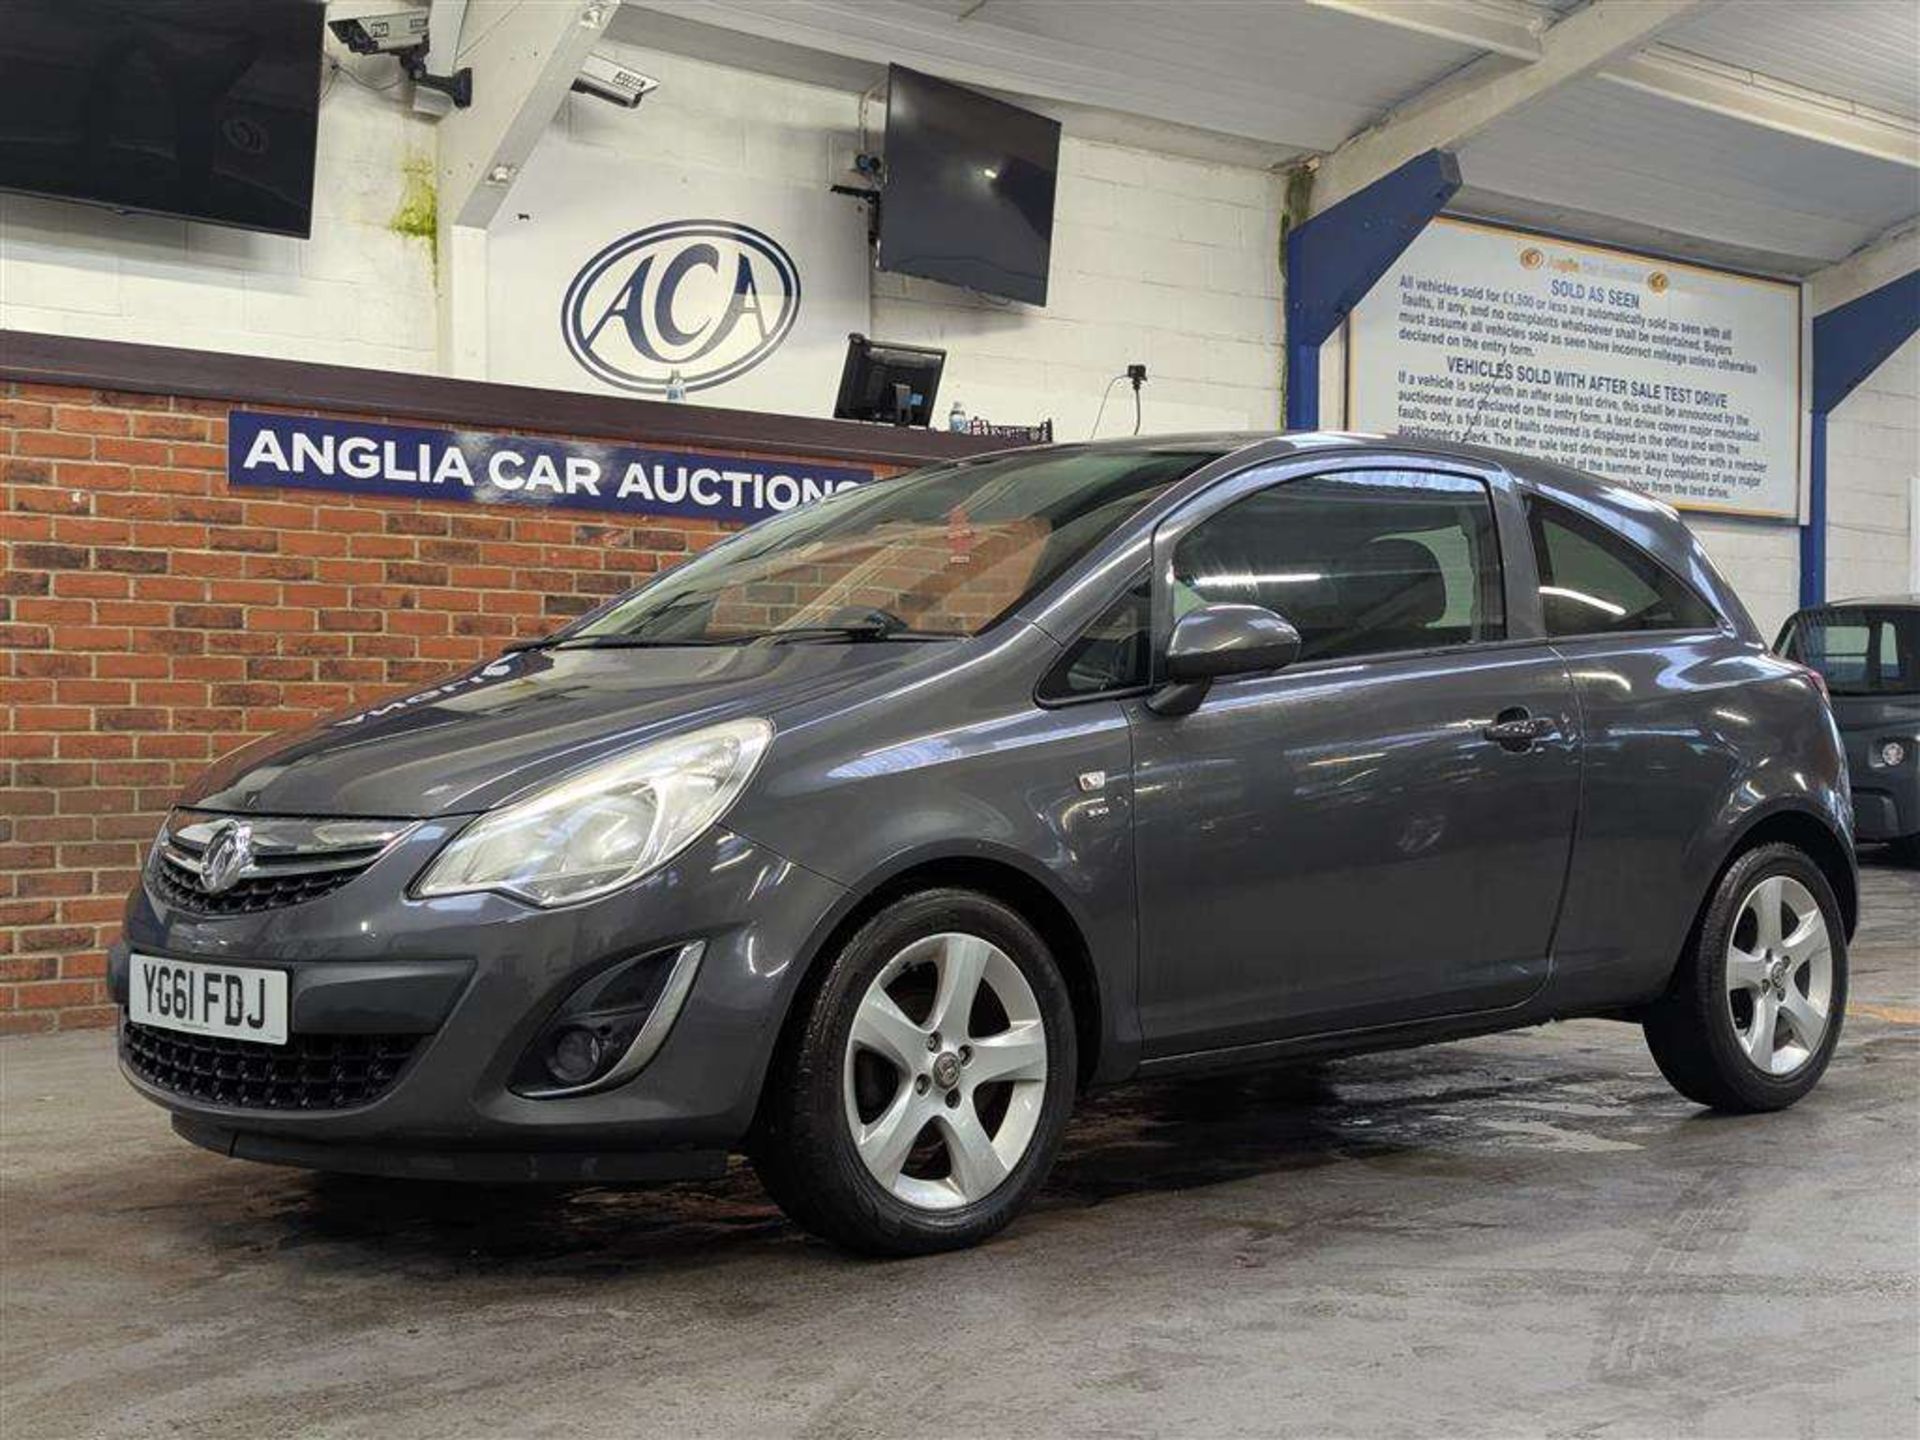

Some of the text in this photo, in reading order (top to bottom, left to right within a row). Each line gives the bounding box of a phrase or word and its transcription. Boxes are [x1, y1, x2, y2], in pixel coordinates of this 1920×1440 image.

[584, 243, 766, 363] ACA
[1399, 275, 1414, 289] All
[1417, 279, 1461, 297] vehicles
[1463, 287, 1484, 300] sold
[1486, 289, 1500, 303] for
[1537, 300, 1546, 310] or
[1648, 317, 1667, 330] sold
[1681, 324, 1701, 335] seen
[1703, 326, 1720, 338] with
[1722, 329, 1733, 340] all
[1552, 280, 1640, 310] SOLD AS SEEN
[1398, 327, 1444, 345] declared
[1447, 337, 1460, 347] on
[1462, 337, 1479, 350] the
[1481, 341, 1507, 356] entry
[1399, 314, 1426, 326] must
[1427, 318, 1468, 332] assume
[1471, 322, 1483, 334] all
[1485, 325, 1527, 340] vehicles
[1528, 332, 1549, 343] sold
[1550, 336, 1562, 345] as
[1564, 338, 1586, 349] seen
[1588, 339, 1609, 352] have
[1612, 344, 1652, 359] incorrect
[1471, 306, 1490, 318] and
[1492, 310, 1504, 320] no
[1507, 312, 1559, 328] complaints
[1616, 327, 1636, 340] shall
[1639, 330, 1649, 342] be
[1409, 376, 1416, 384] a
[1417, 375, 1454, 389] vehicle
[1457, 380, 1465, 390] is
[1494, 385, 1514, 396] with
[1516, 389, 1528, 398] an
[1530, 389, 1551, 401] after
[1554, 393, 1574, 404] sale
[1576, 394, 1592, 406] test
[1665, 406, 1676, 416] be
[1725, 413, 1735, 426] by
[1736, 415, 1749, 425] the
[1516, 366, 1551, 385] SOLD
[1554, 371, 1585, 390] WITH
[1589, 376, 1627, 395] AFTER
[1631, 381, 1661, 399] SALE
[1664, 386, 1692, 403] TEST
[1695, 390, 1727, 408] DRIVE
[1398, 392, 1453, 407] auctioneer
[1456, 398, 1475, 409] and
[1523, 408, 1535, 416] on
[1537, 407, 1551, 418] the
[1554, 410, 1578, 423] entry
[1606, 415, 1612, 425] A
[1614, 416, 1633, 427] test
[1635, 419, 1656, 430] drive
[1658, 424, 1687, 434] covers
[1398, 407, 1427, 420] faults
[1457, 416, 1463, 424] a
[1485, 416, 1501, 428] list
[1502, 419, 1512, 430] of
[1515, 420, 1541, 433] faults
[1543, 426, 1580, 437] covered
[1583, 429, 1592, 438] is
[1593, 429, 1637, 445] displayed
[1639, 435, 1647, 444] in
[1648, 435, 1663, 446] the
[1665, 437, 1689, 449] office
[1691, 441, 1706, 451] and
[1709, 443, 1726, 453] with
[243, 430, 474, 486] ANGLIA
[488, 450, 600, 495] CAR
[1495, 434, 1512, 446] The
[1514, 436, 1536, 448] after
[1540, 439, 1558, 451] sale
[1560, 441, 1578, 453] test
[1581, 443, 1602, 455] drive
[1629, 448, 1640, 459] be
[1647, 465, 1662, 478] Any
[1712, 472, 1720, 482] of
[144, 963, 265, 1030] YG61 FDJ
